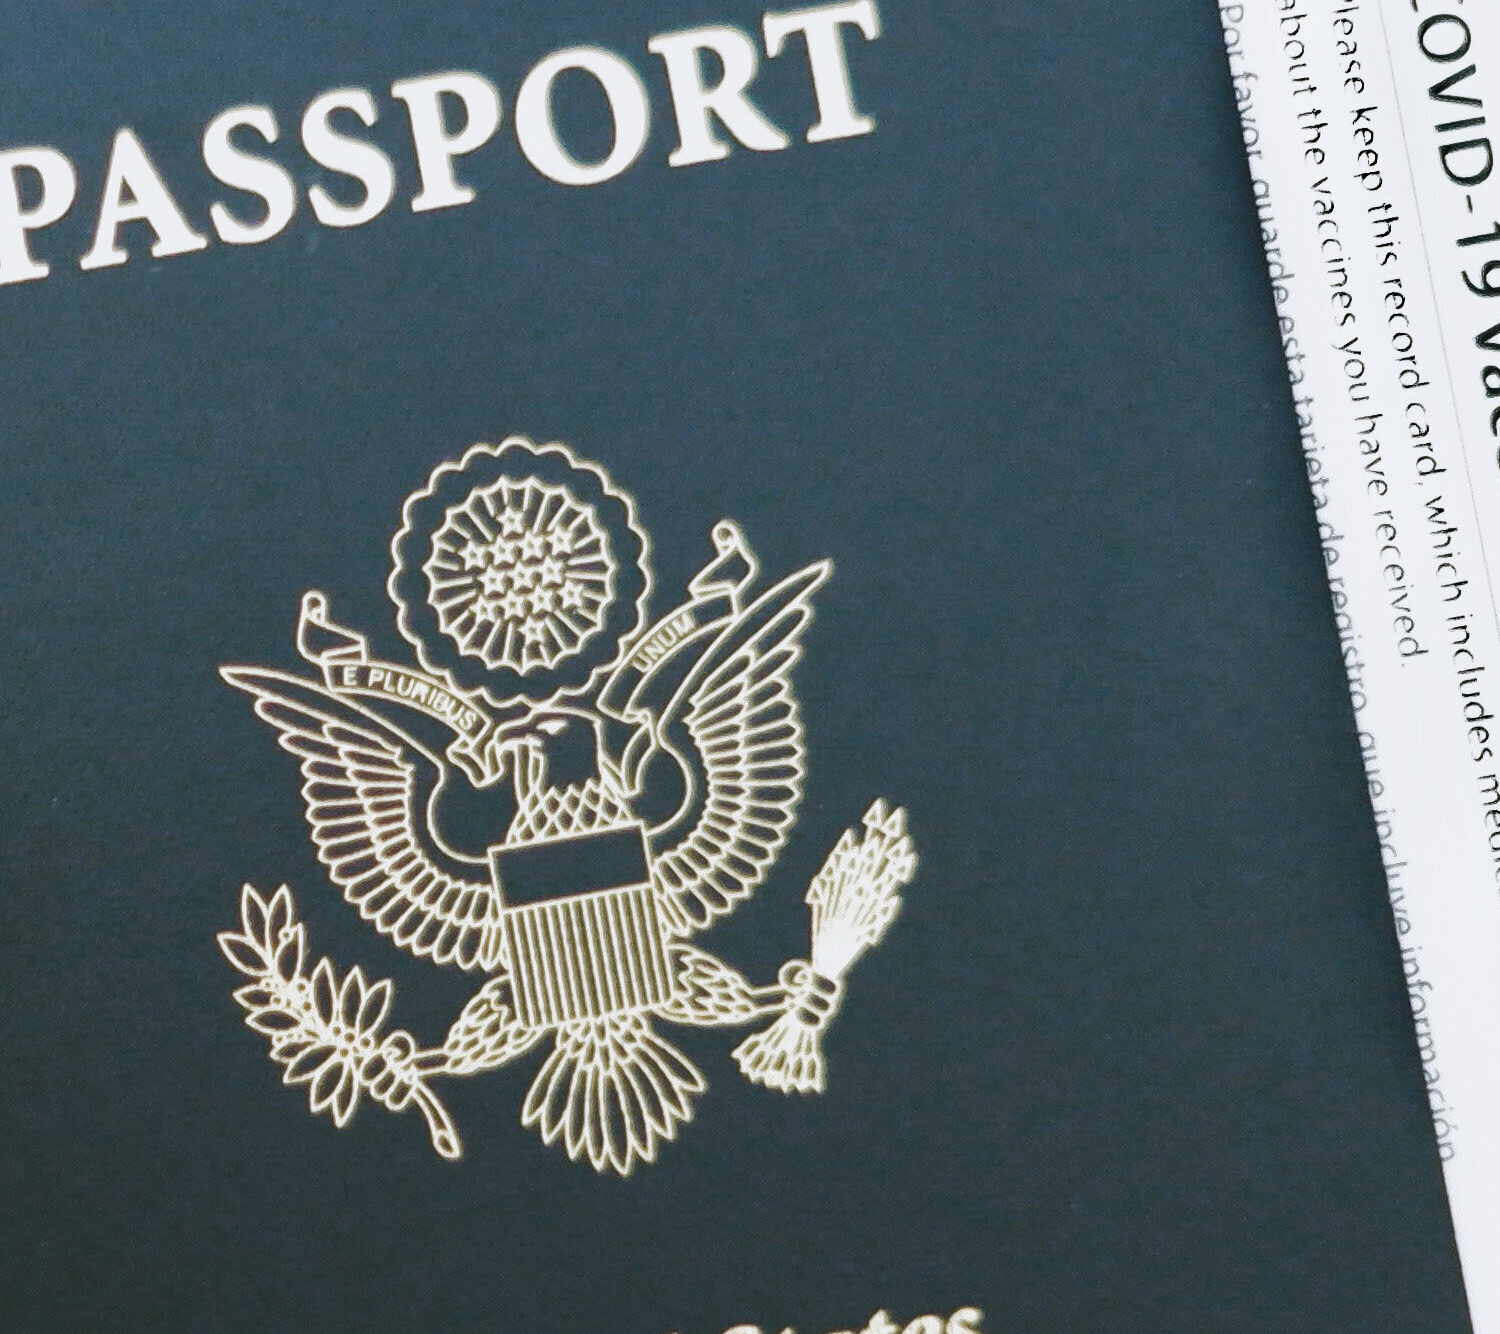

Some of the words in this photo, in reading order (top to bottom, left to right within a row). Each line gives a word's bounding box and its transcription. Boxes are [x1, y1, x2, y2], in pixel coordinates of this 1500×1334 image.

[1296, 107, 1329, 166] the
[1349, 105, 1384, 193] keep
[1309, 176, 1357, 328] vaccines
[1367, 201, 1402, 267] this
[1221, 3, 1245, 60] Por
[1280, 314, 1306, 386] esta
[1320, 521, 1345, 567] de
[1331, 336, 1370, 403] you
[1383, 277, 1432, 390] record
[1353, 412, 1389, 497] have
[1404, 401, 1448, 486] card,
[1372, 509, 1429, 667] received.
[1423, 494, 1469, 603] which
[631, 613, 696, 673] UNUM
[343, 666, 358, 686] E
[368, 667, 477, 730] PLURIBUS
[1445, 613, 1496, 764] includes
